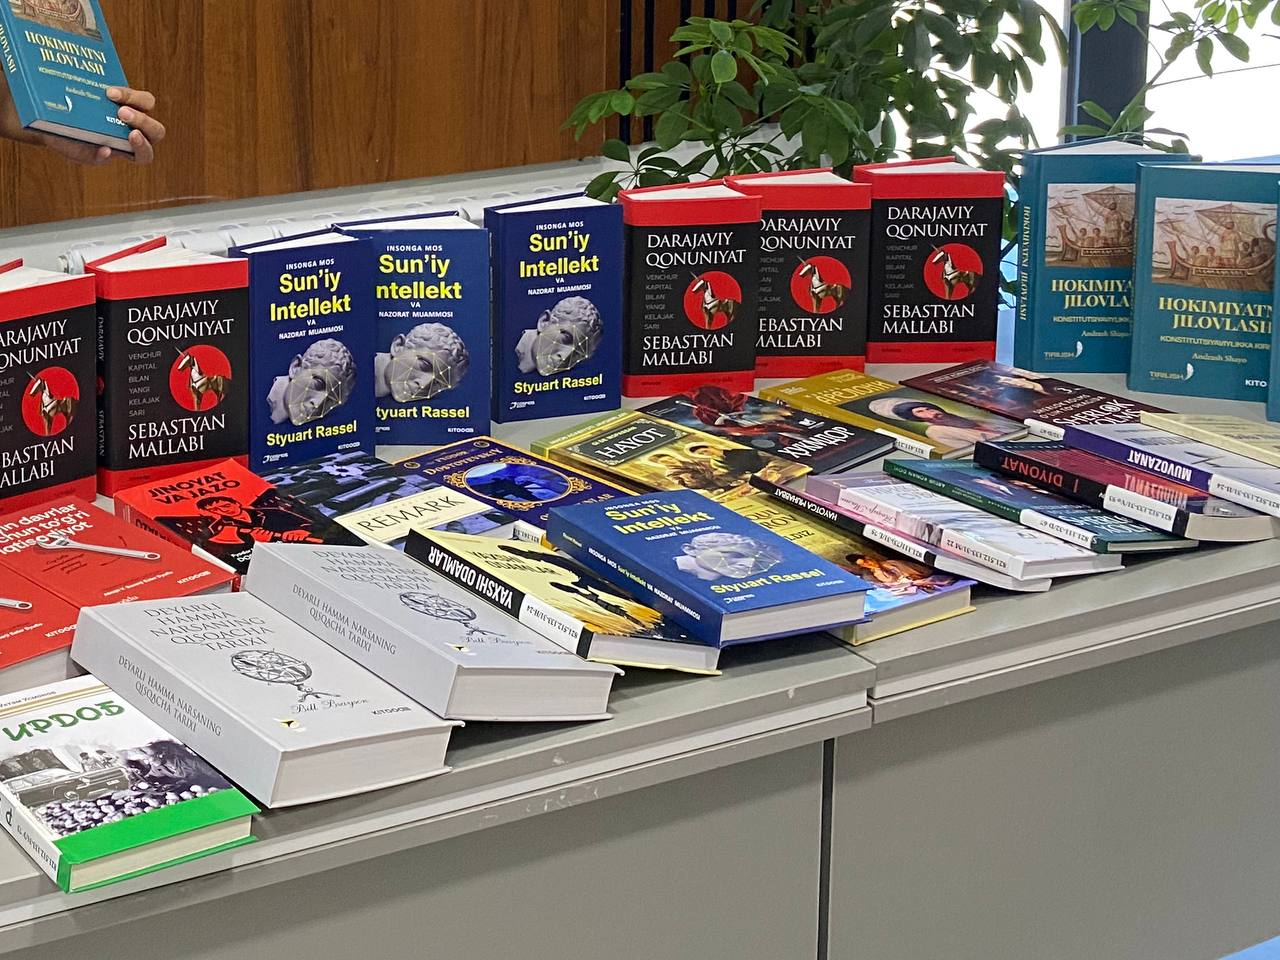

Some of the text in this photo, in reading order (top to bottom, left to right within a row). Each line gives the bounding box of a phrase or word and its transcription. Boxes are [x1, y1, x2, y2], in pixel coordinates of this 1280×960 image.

[24, 30, 107, 64] HOKIMIYATNI
[40, 47, 105, 76] JILOVLASH
[887, 206, 974, 222] DARAJAVIY
[536, 222, 567, 230] INSONGA
[886, 223, 988, 240] QONUNIYAT
[647, 232, 733, 250] DARAJAVIY
[286, 258, 334, 270] INSONGA MOS
[519, 255, 599, 278] Intellekt
[646, 250, 746, 269] QONUNIYAT
[557, 284, 591, 293] MUAMMOSI
[128, 299, 219, 323] DARAJAVIY
[270, 294, 351, 321] Intellekt
[883, 304, 975, 318] SEBASTYAN
[127, 319, 234, 346] QONUNIYAT
[279, 325, 343, 340] NAZORAT MUAMMOSI
[883, 320, 954, 334] MALLABI
[643, 333, 733, 350] SEBASTYAN
[128, 350, 161, 360] VENCHUR
[642, 350, 713, 366] MALLABI
[128, 363, 157, 372] KAPITAL
[129, 375, 149, 383] BILAN
[514, 374, 603, 395] Styuart Rassel
[129, 386, 150, 394] YANGI
[129, 396, 160, 406] KELAJAK
[129, 409, 145, 417] SARI
[421, 406, 470, 418] Rassel
[129, 413, 226, 440] SEBASTYAN
[267, 420, 357, 447] Styuart Rassel
[129, 435, 204, 459] MALLABI
[595, 427, 667, 459] HAYOT
[1002, 456, 1063, 487] DIYONAT
[1128, 449, 1192, 482] MUVOZANAT
[148, 471, 227, 497] JINOYAT
[155, 480, 241, 504] VA JAZO
[775, 488, 806, 508] MUHABBAT
[18, 504, 78, 525] davrlar
[357, 495, 465, 532] REMARK
[805, 503, 838, 522] HAYOTGA
[612, 512, 715, 535] Intellekt
[312, 550, 386, 560] DEYARLI
[328, 558, 400, 568] HAMMA
[321, 564, 428, 577] NARSANING
[428, 546, 513, 610] YAXSHI ODAMLAR
[374, 581, 432, 590] TARIXI
[710, 569, 826, 593] Styuart Rassel
[144, 603, 221, 617] DEYARLI
[157, 612, 235, 626] HAMMA
[292, 584, 397, 655] DEYARLI HAMMA NARSANING
[150, 617, 265, 637] NARSANING
[171, 626, 275, 646] QISQACHA
[309, 607, 372, 653] QISQACHA TARIXI
[206, 637, 267, 651] TARIXI
[118, 655, 222, 736] DEYARLI HAMMA NARSANING
[135, 681, 197, 732] QISQACHA TARIXI
